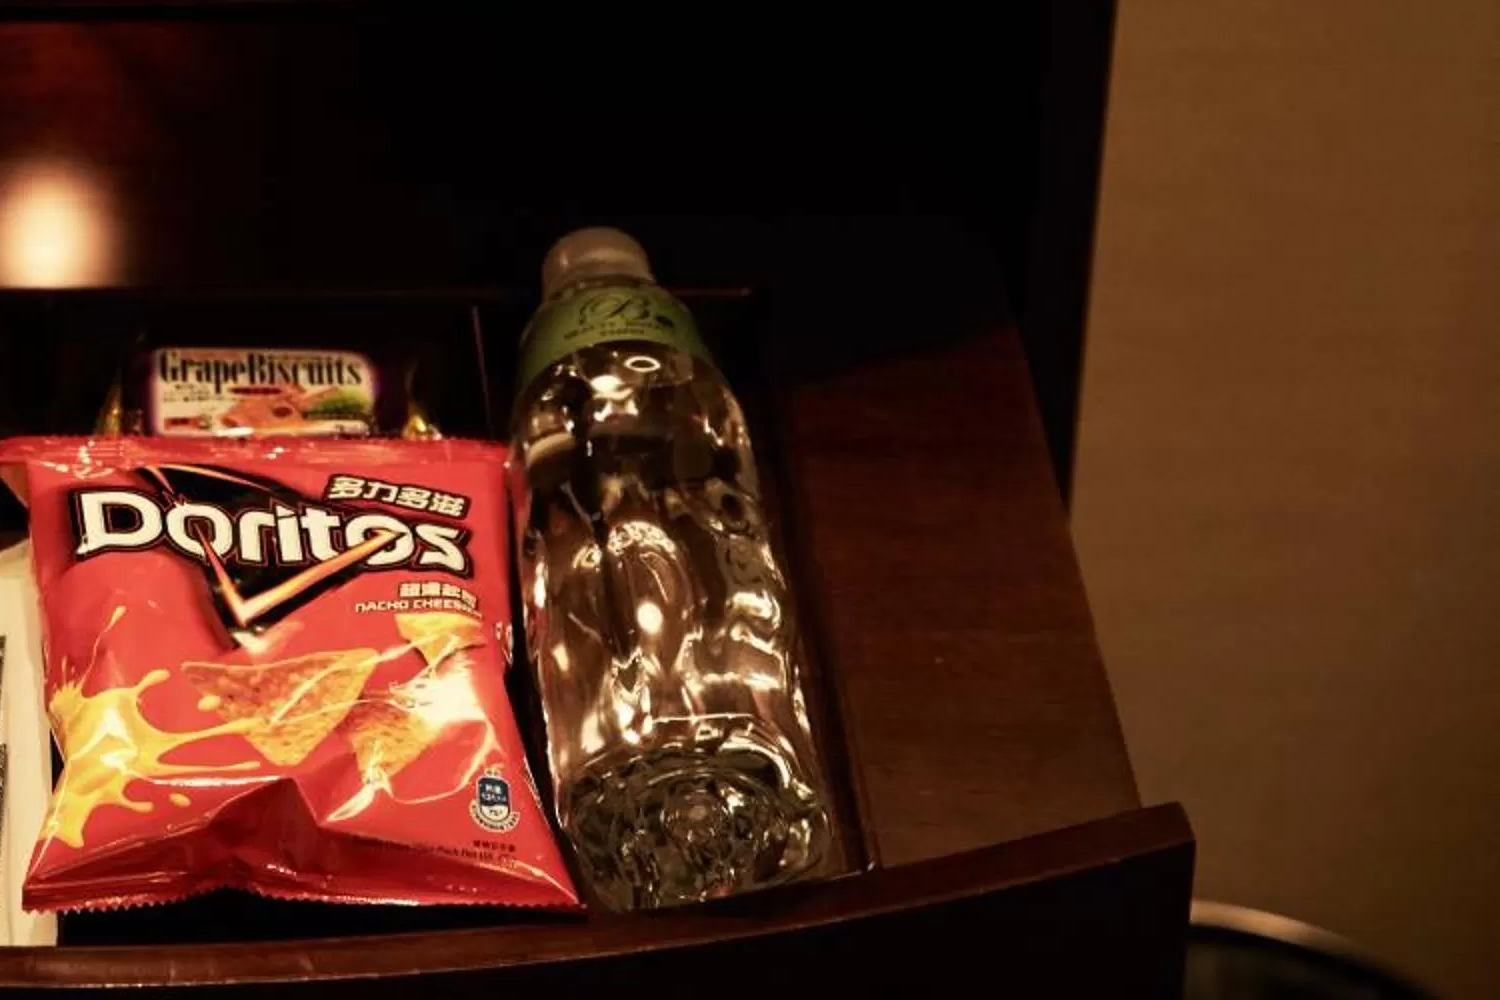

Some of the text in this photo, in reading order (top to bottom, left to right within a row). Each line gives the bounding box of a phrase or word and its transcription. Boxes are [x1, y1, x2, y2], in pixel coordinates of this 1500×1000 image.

[159, 351, 362, 394] GrapeBiscuits
[328, 475, 465, 517] 多力多滋
[77, 491, 466, 571] Doritos
